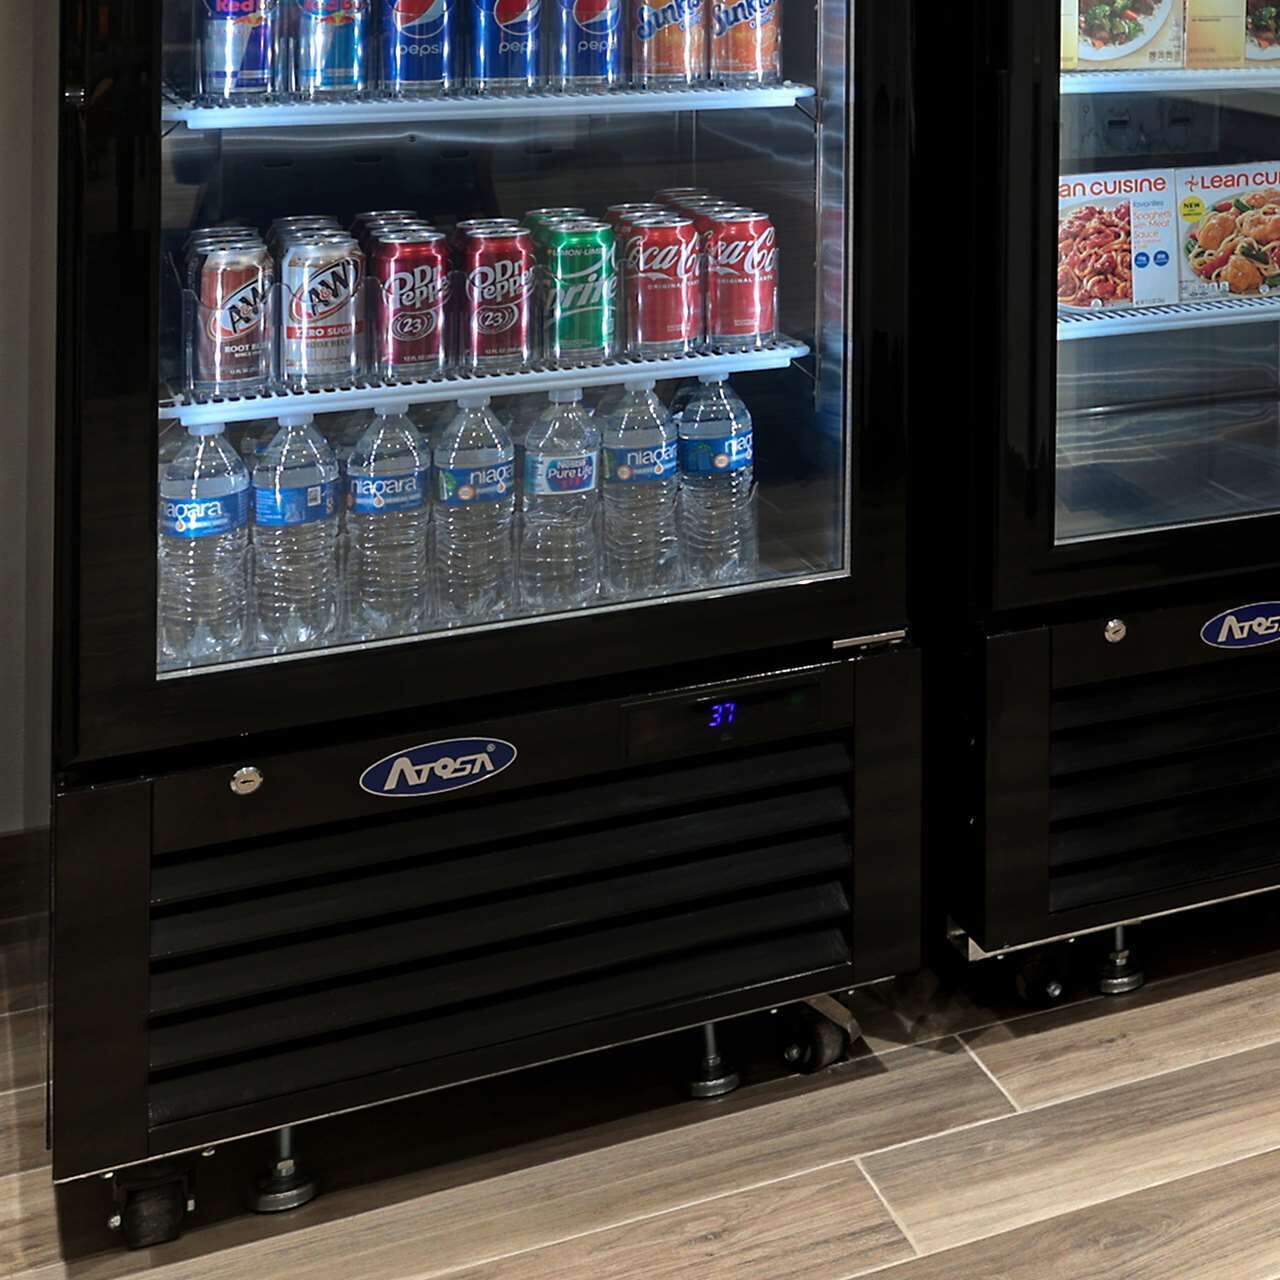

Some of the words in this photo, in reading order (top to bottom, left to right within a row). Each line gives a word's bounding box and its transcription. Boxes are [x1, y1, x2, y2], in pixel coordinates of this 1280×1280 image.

[399, 41, 443, 56] pepsi
[498, 40, 537, 54] pepsi
[577, 39, 617, 53] pepsi
[414, 265, 443, 288] Dr
[495, 260, 523, 280] Dr
[308, 259, 358, 317] A&W
[384, 271, 450, 308] Peppe
[546, 273, 617, 310] prite
[402, 318, 422, 332] 23
[484, 311, 503, 326] 23
[548, 467, 580, 480] Pure
[351, 477, 417, 496] niagara
[708, 702, 736, 727] 37
